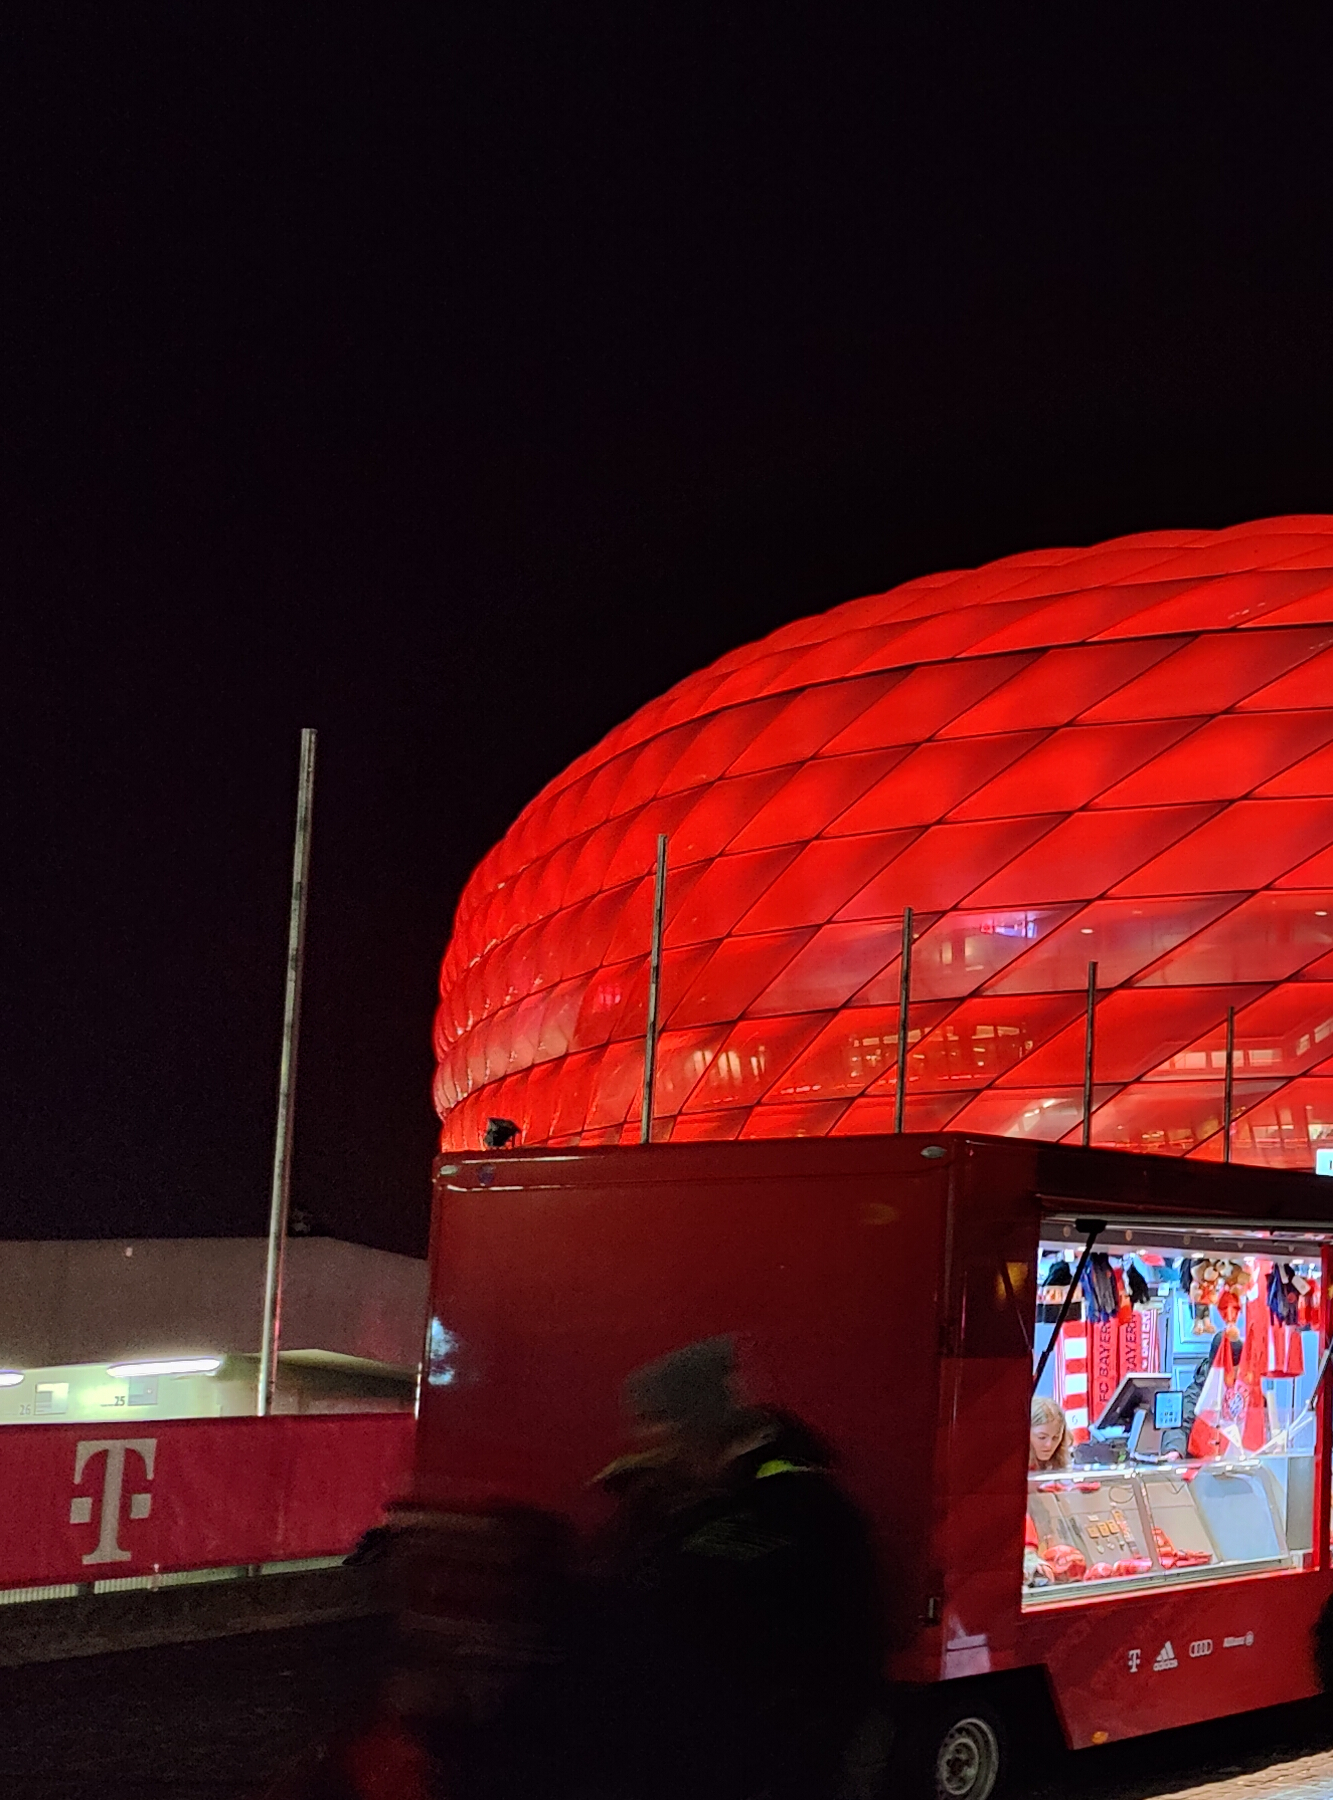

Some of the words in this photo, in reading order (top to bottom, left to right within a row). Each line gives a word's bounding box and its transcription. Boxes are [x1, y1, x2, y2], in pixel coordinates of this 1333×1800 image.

[1099, 1318, 1111, 1377] BAYER
[19, 1405, 31, 1416] 26
[114, 1396, 126, 1407] 25
[70, 1438, 157, 1565] T
[1128, 1649, 1141, 1673] T
[1153, 1659, 1178, 1671] adidas
